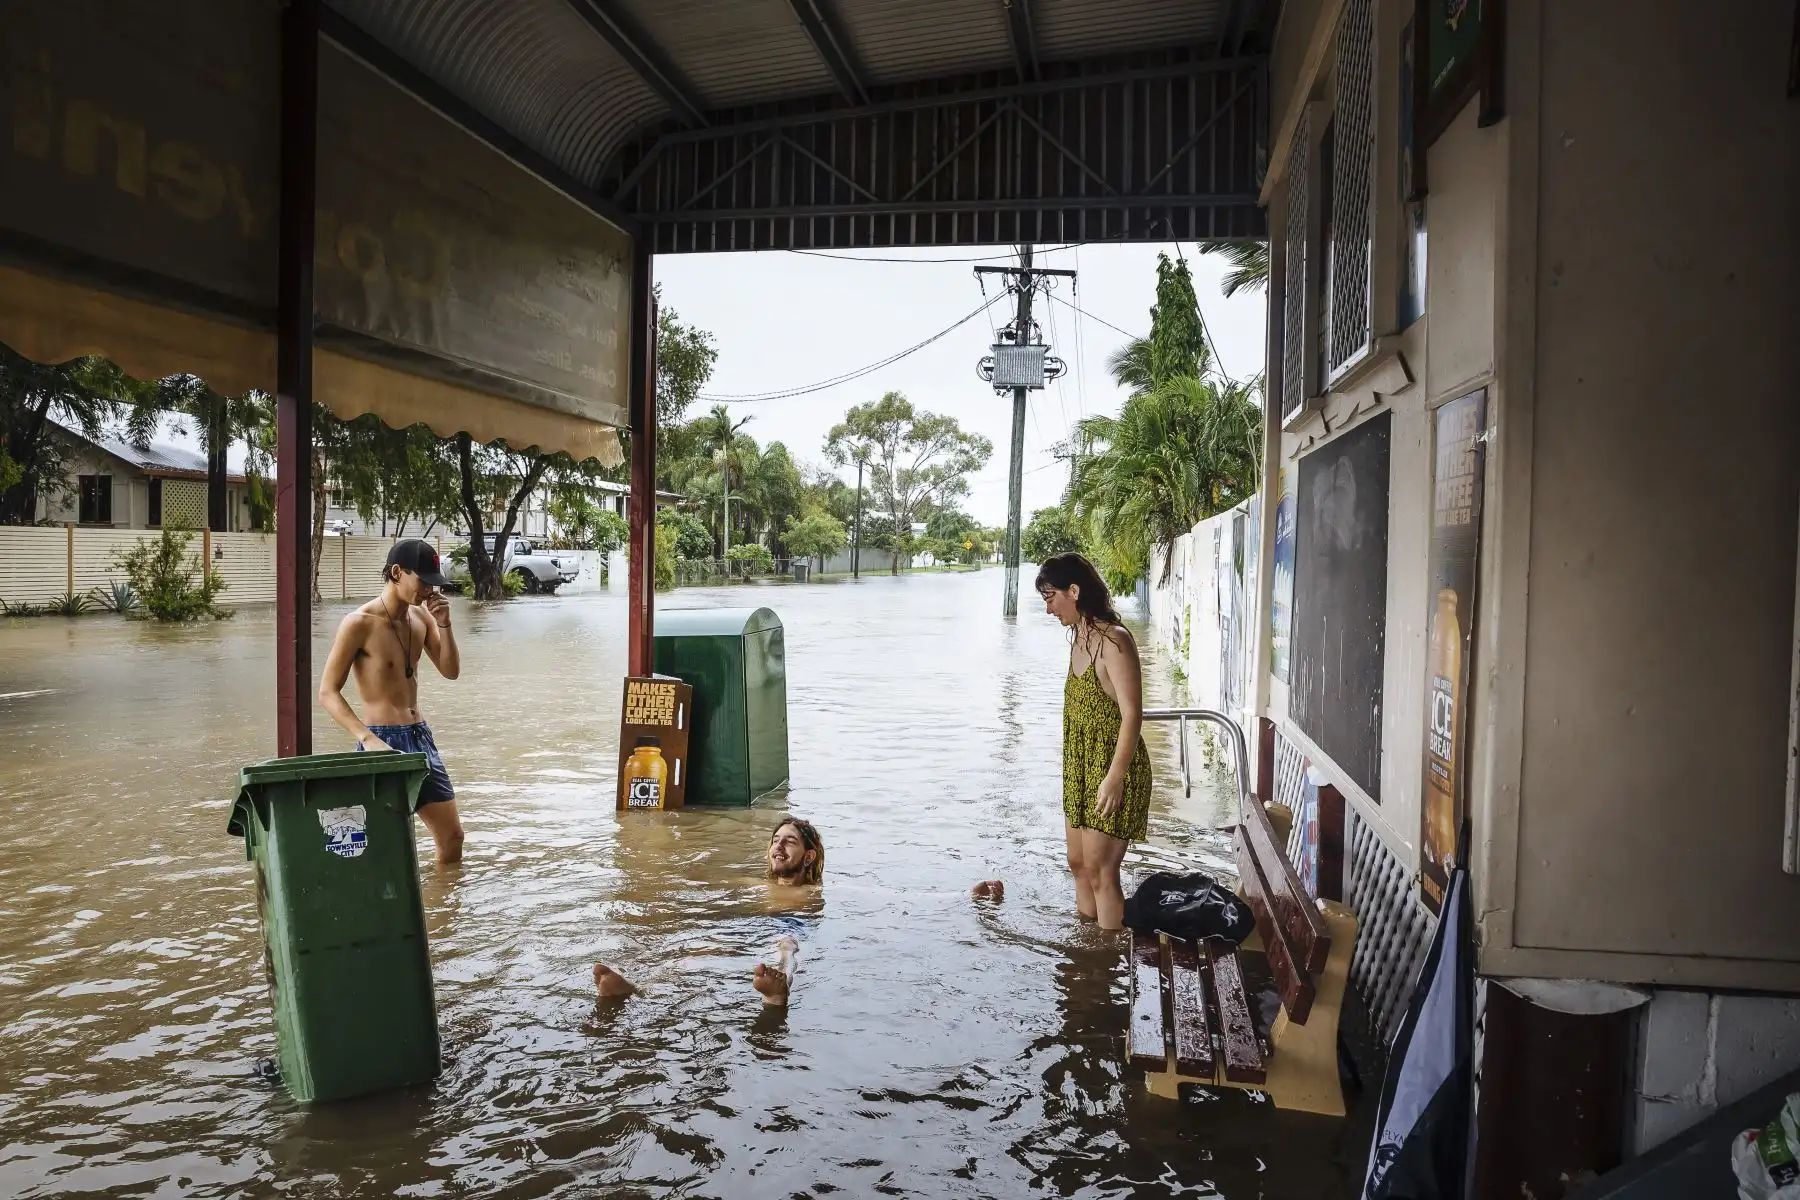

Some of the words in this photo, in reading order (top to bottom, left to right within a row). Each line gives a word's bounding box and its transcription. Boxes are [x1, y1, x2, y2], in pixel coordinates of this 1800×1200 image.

[628, 681, 676, 696] MAKES
[626, 693, 675, 708] OTHER
[625, 706, 674, 720] COFFEE
[1430, 690, 1454, 740] ICE
[1429, 731, 1452, 761] BREAK
[629, 782, 660, 799] ICE
[628, 798, 659, 807] BREAK
[326, 841, 367, 852] TOWNSVILLE
[341, 849, 354, 857] CITY
